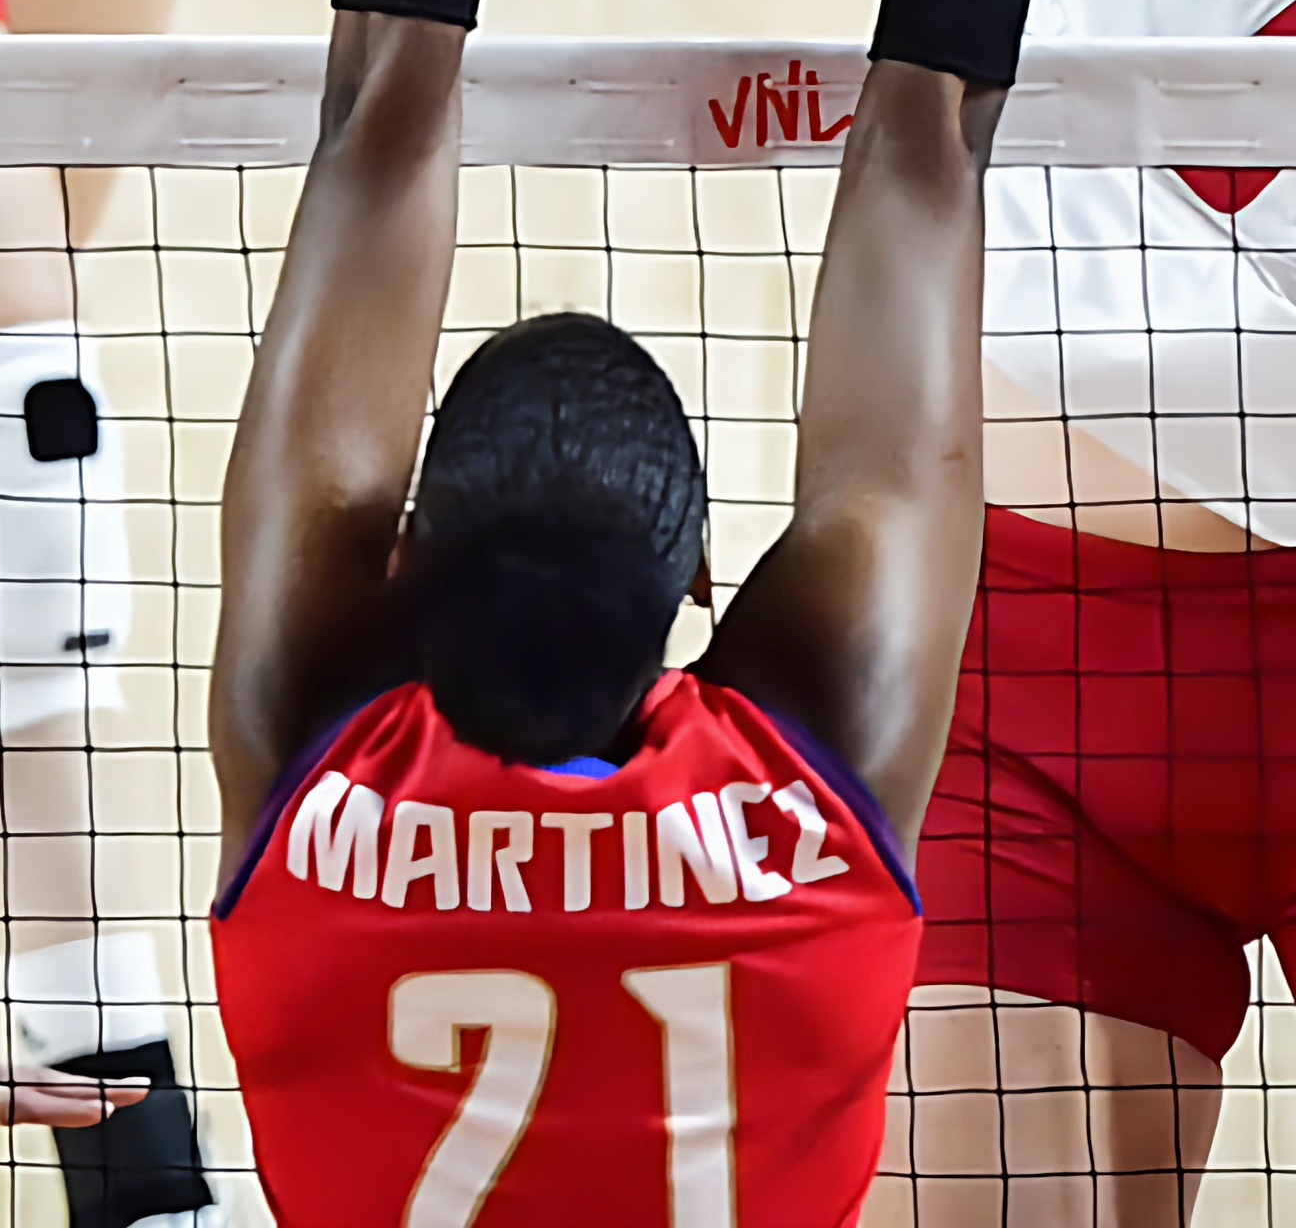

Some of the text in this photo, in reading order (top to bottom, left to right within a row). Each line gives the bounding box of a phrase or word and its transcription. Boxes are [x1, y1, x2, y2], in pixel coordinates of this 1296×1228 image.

[708, 60, 855, 148] VNL
[287, 770, 850, 913] MARTINEZ
[388, 961, 738, 1228] 21
